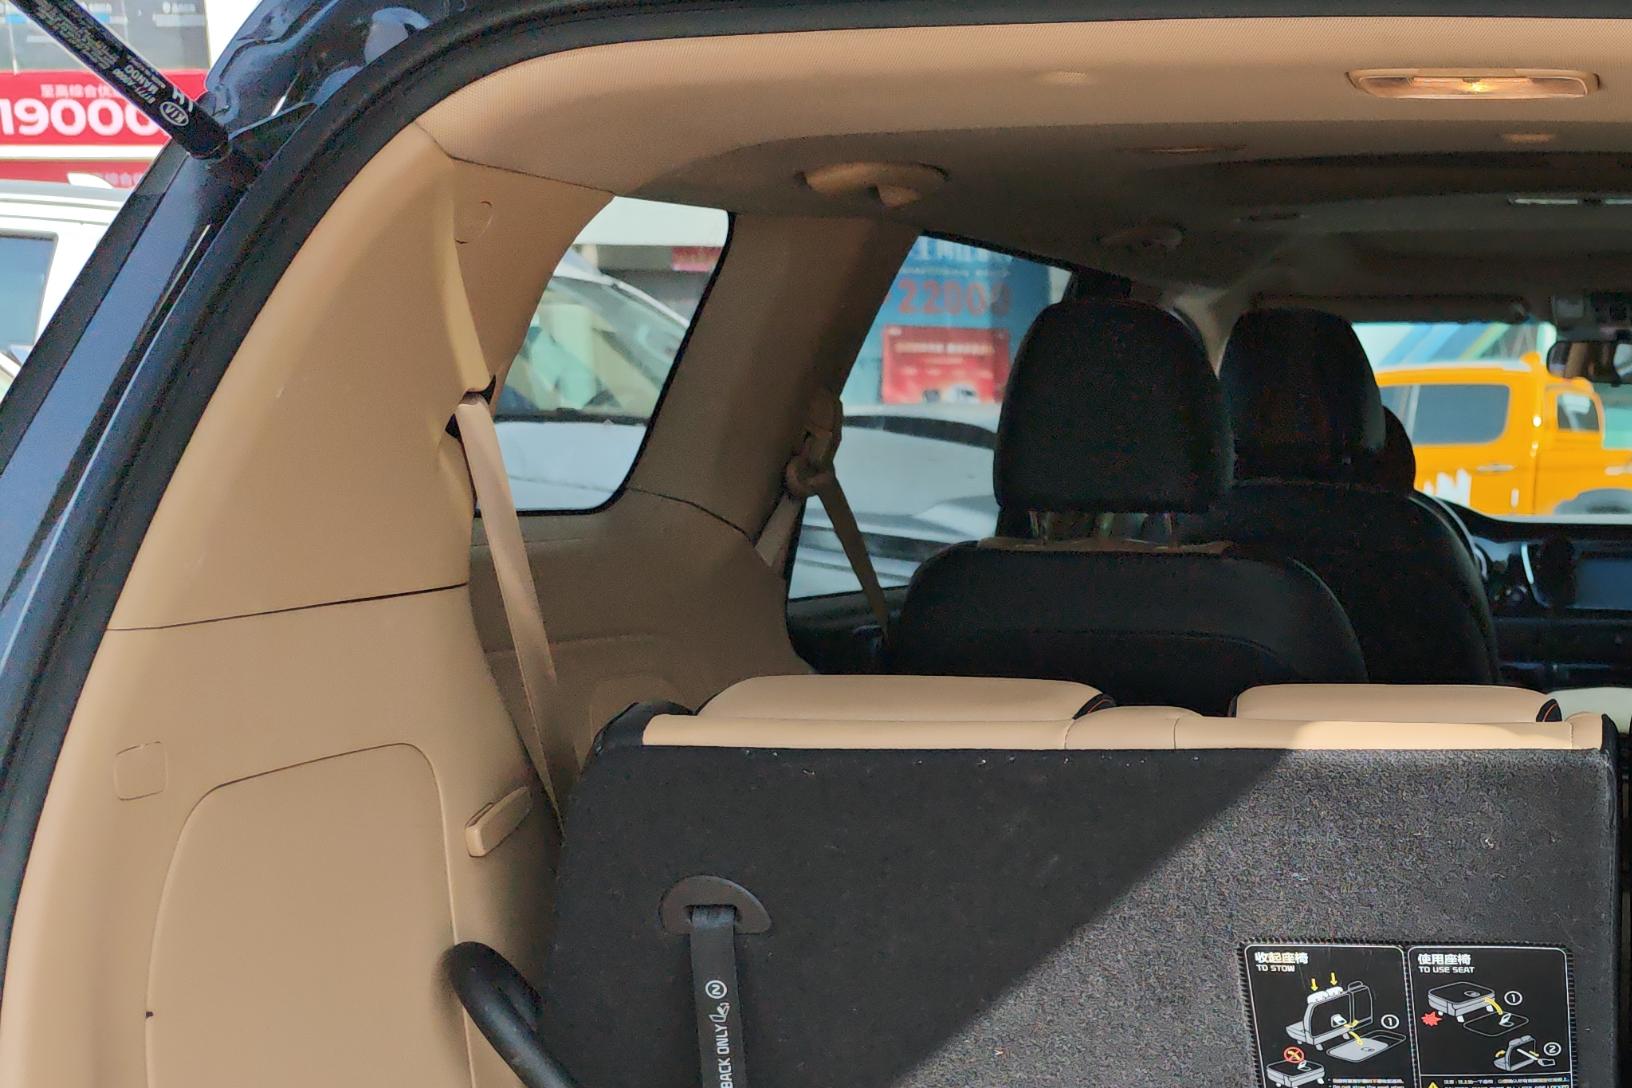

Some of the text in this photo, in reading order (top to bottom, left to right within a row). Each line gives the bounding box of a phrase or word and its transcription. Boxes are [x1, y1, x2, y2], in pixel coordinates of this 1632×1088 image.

[162, 103, 187, 125] KIA
[1417, 953, 1472, 966] 使用座椅
[1256, 964, 1269, 972] TO
[1432, 966, 1450, 974] USE
[1452, 966, 1475, 974] SEAT
[714, 1023, 730, 1054] ONLY
